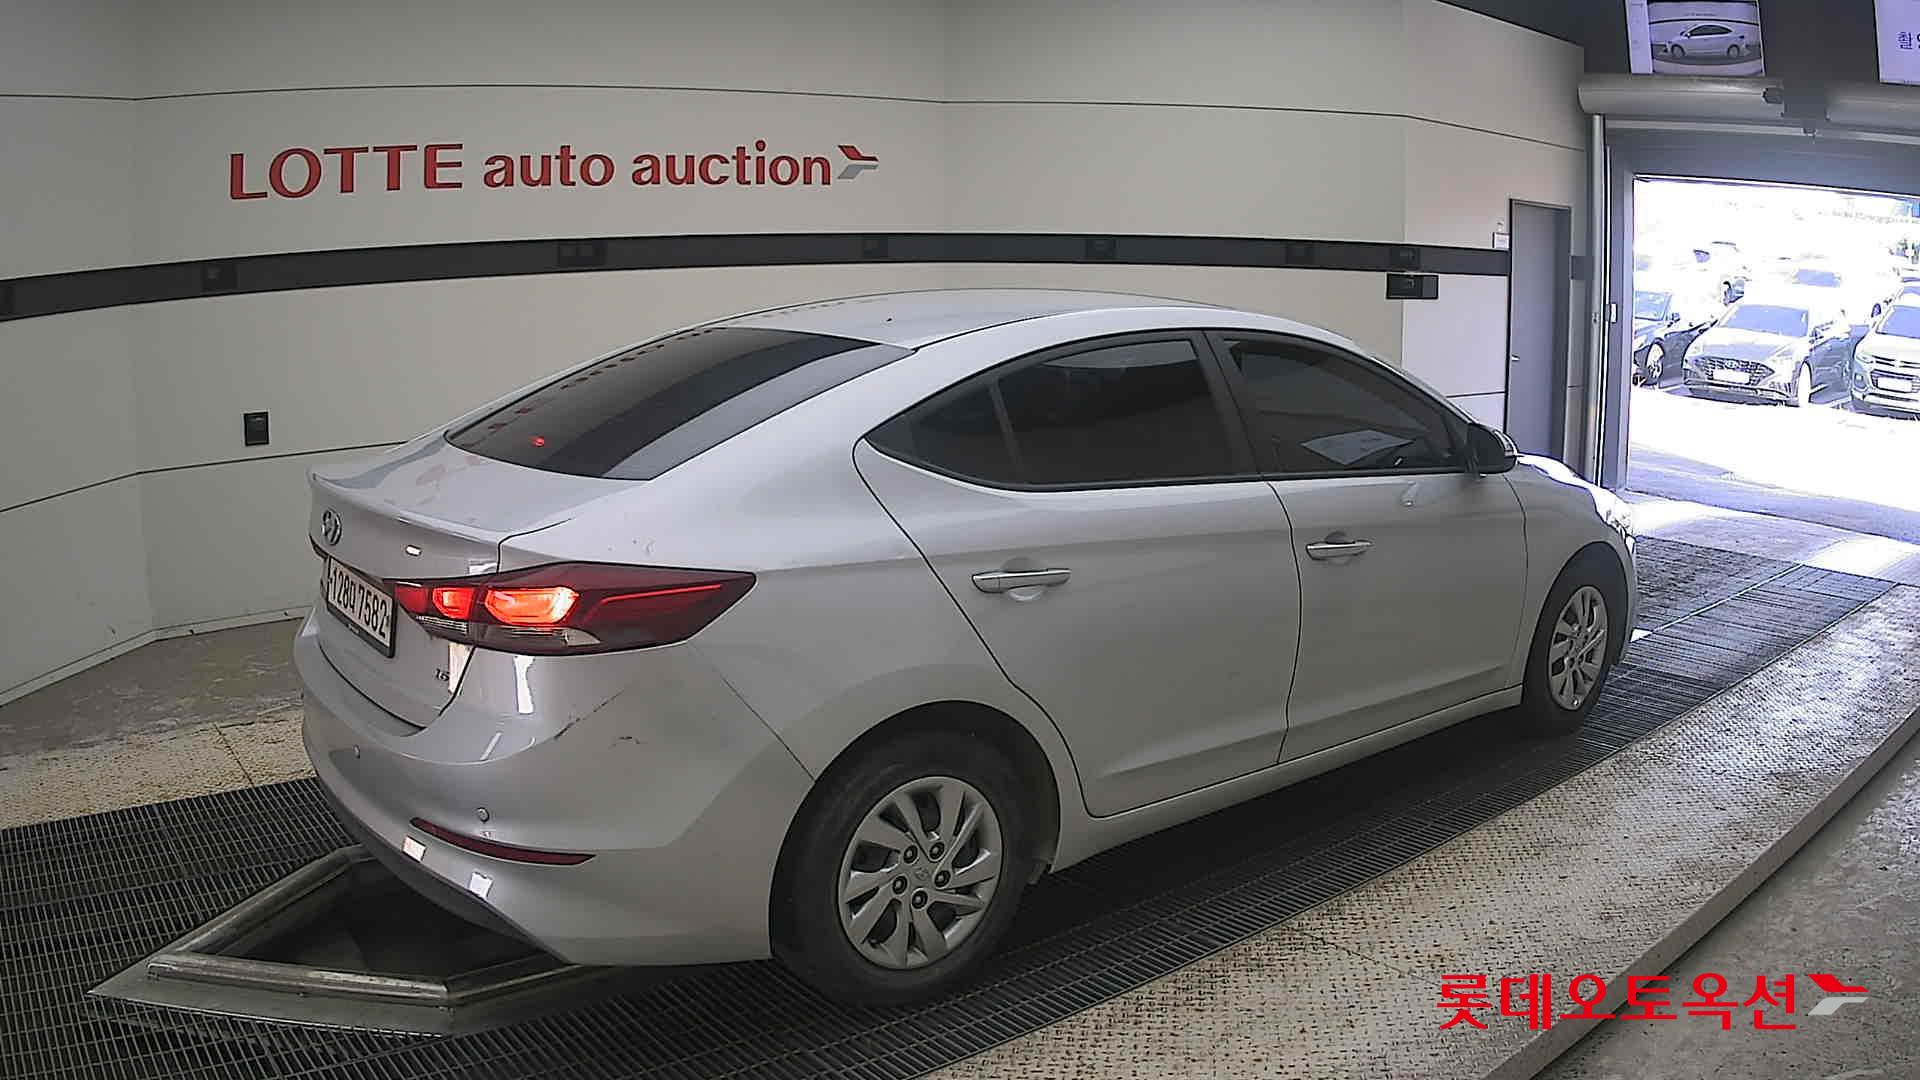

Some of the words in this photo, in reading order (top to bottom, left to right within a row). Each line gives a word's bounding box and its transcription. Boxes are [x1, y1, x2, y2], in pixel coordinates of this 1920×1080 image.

[229, 143, 463, 200] LOTTE
[483, 145, 615, 188] auto
[631, 139, 832, 186] auction
[358, 586, 388, 639] 7582
